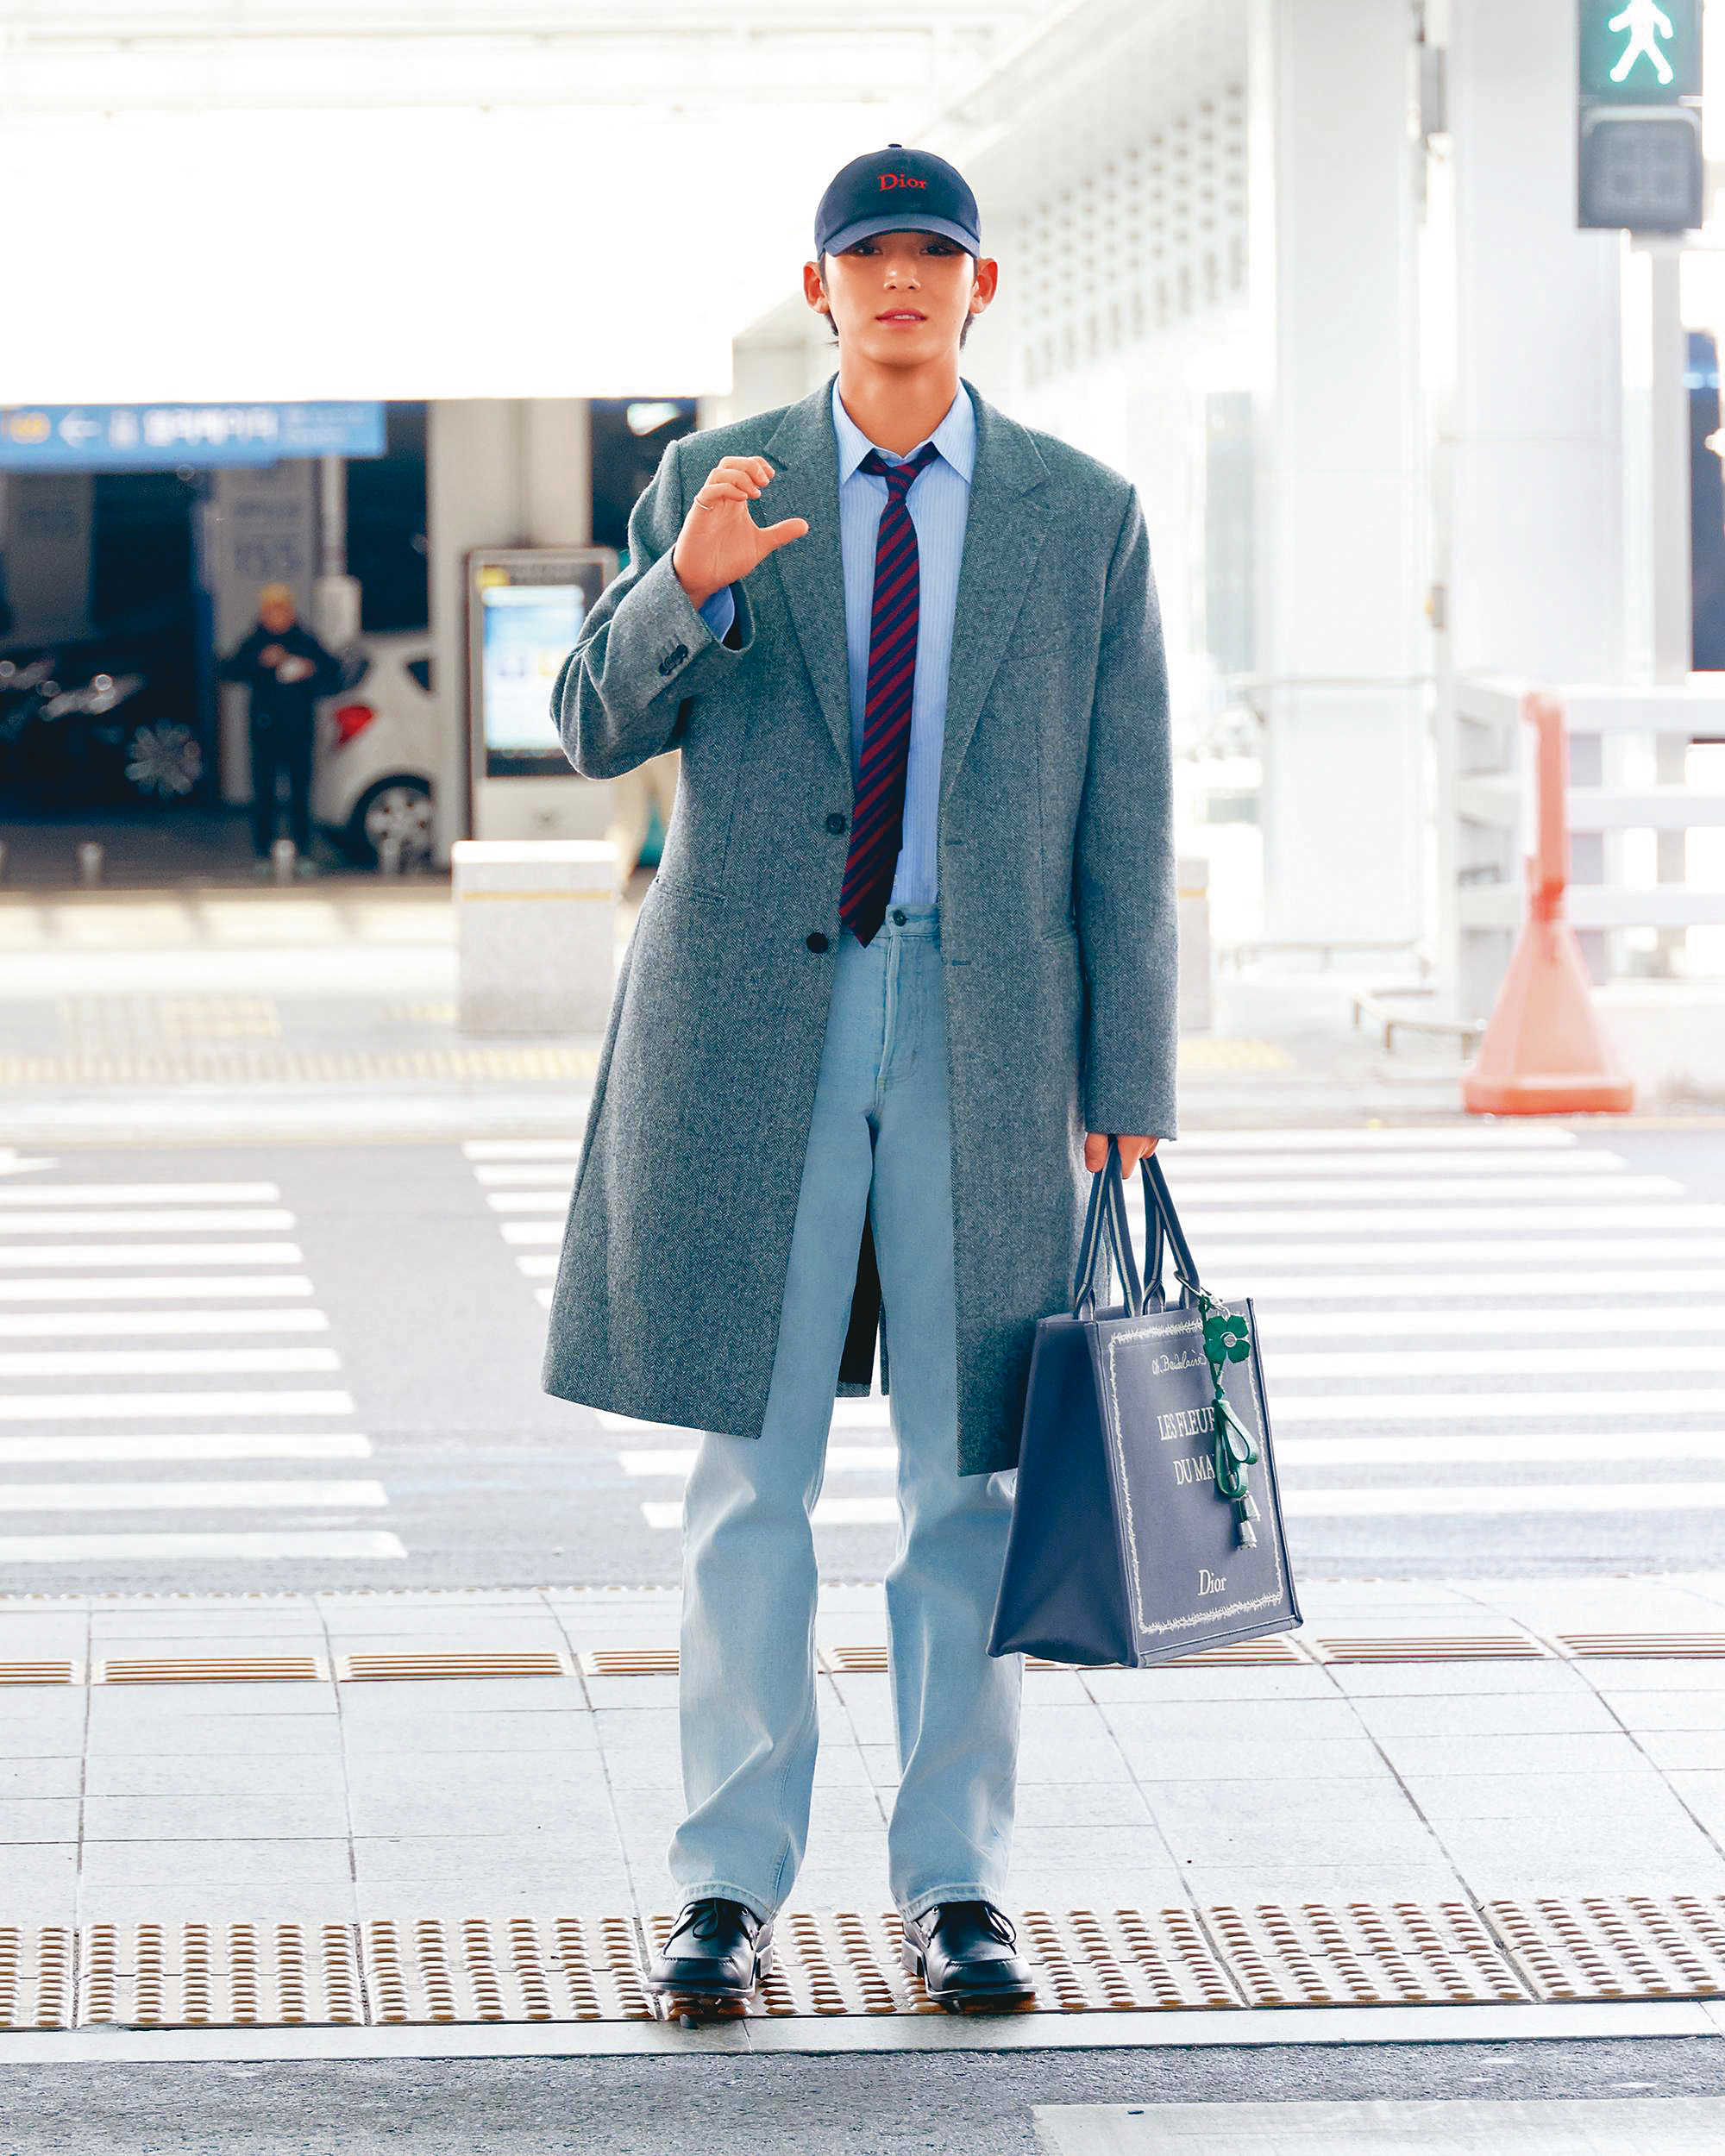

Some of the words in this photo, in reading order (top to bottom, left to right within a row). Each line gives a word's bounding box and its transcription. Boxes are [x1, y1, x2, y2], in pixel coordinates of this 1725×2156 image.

[877, 173, 927, 191] Dior
[1157, 1413, 1177, 1441] LES
[1176, 1407, 1215, 1437] FLEUR
[1173, 1458, 1193, 1485] DU
[1191, 1453, 1215, 1482] MA
[1197, 1569, 1226, 1595] Dior
